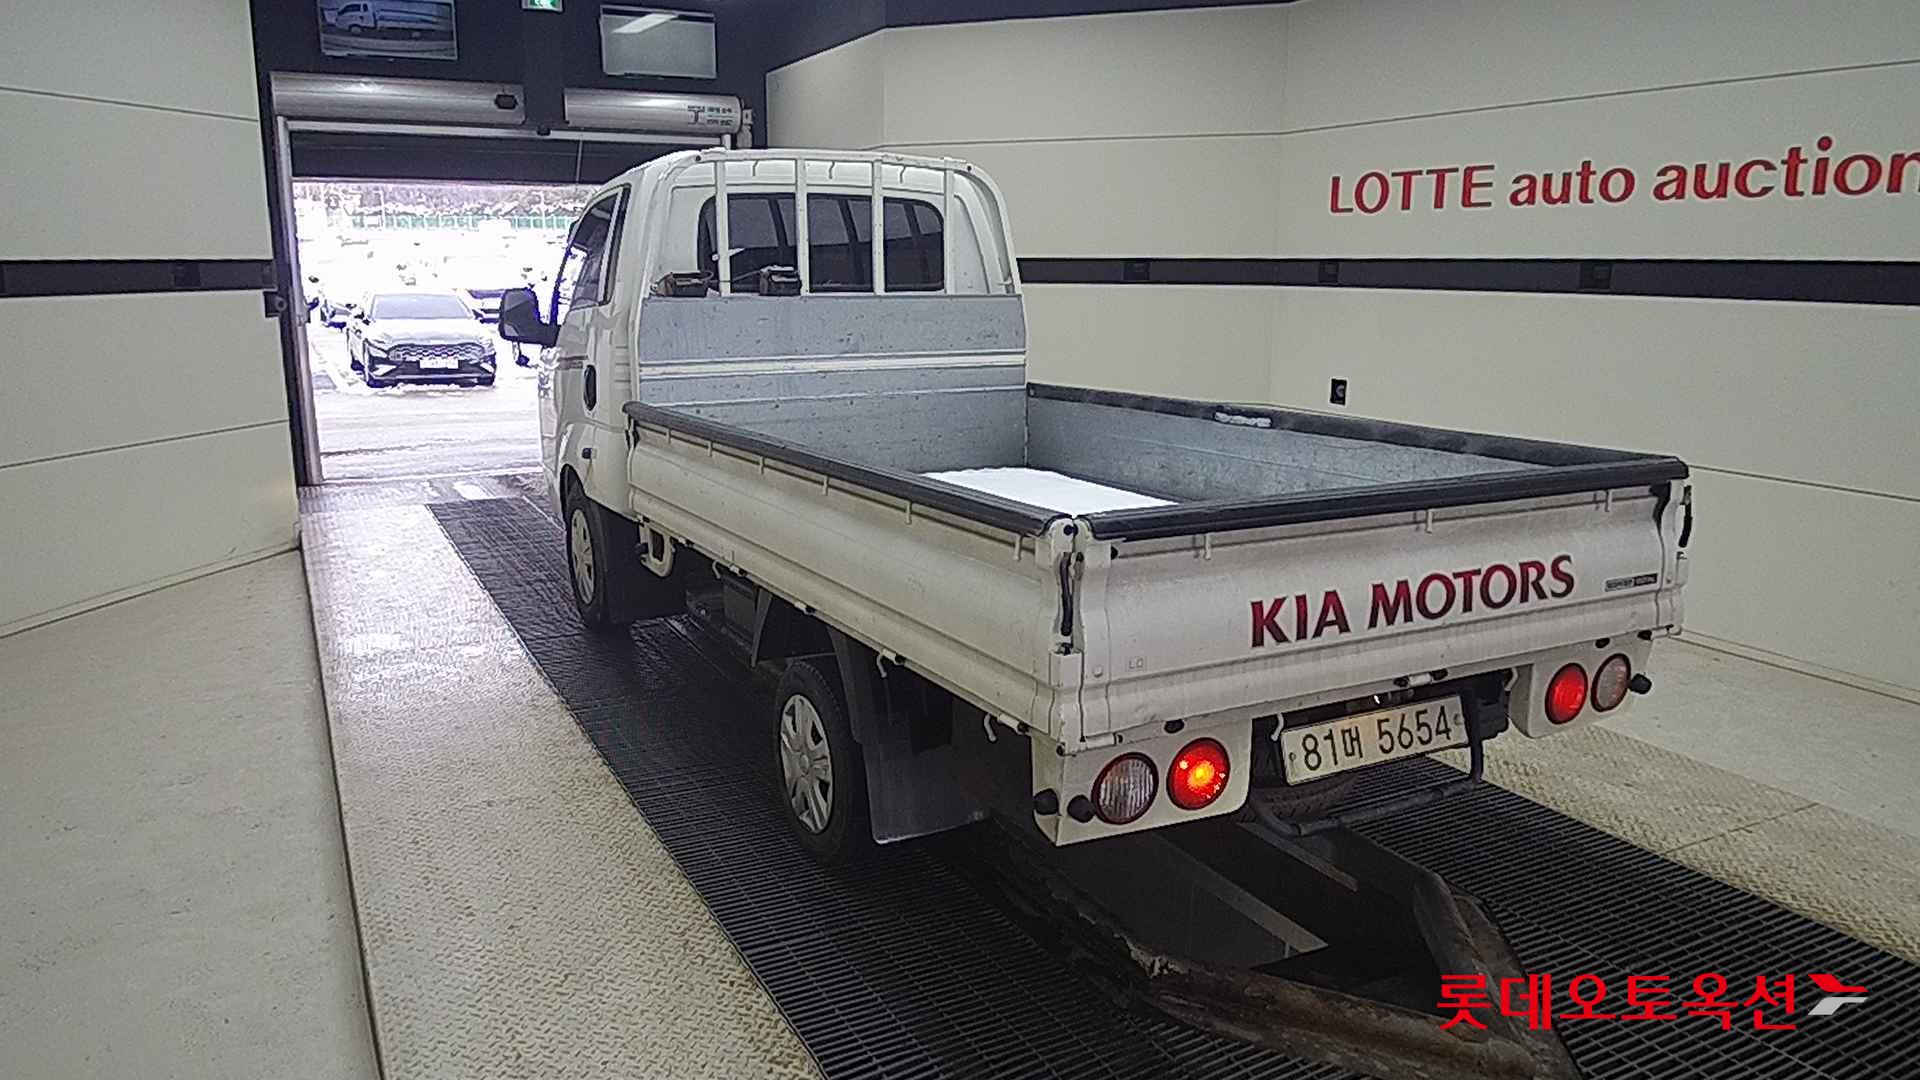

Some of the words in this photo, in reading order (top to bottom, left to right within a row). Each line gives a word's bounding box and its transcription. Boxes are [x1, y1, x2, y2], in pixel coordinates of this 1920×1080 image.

[1330, 164, 1495, 214] LOTTE
[1509, 160, 1635, 206] auto
[1250, 590, 1350, 648] KIA
[1367, 553, 1575, 630] MOTORS
[1302, 726, 1364, 771] 81머
[1376, 705, 1453, 754] 5654
